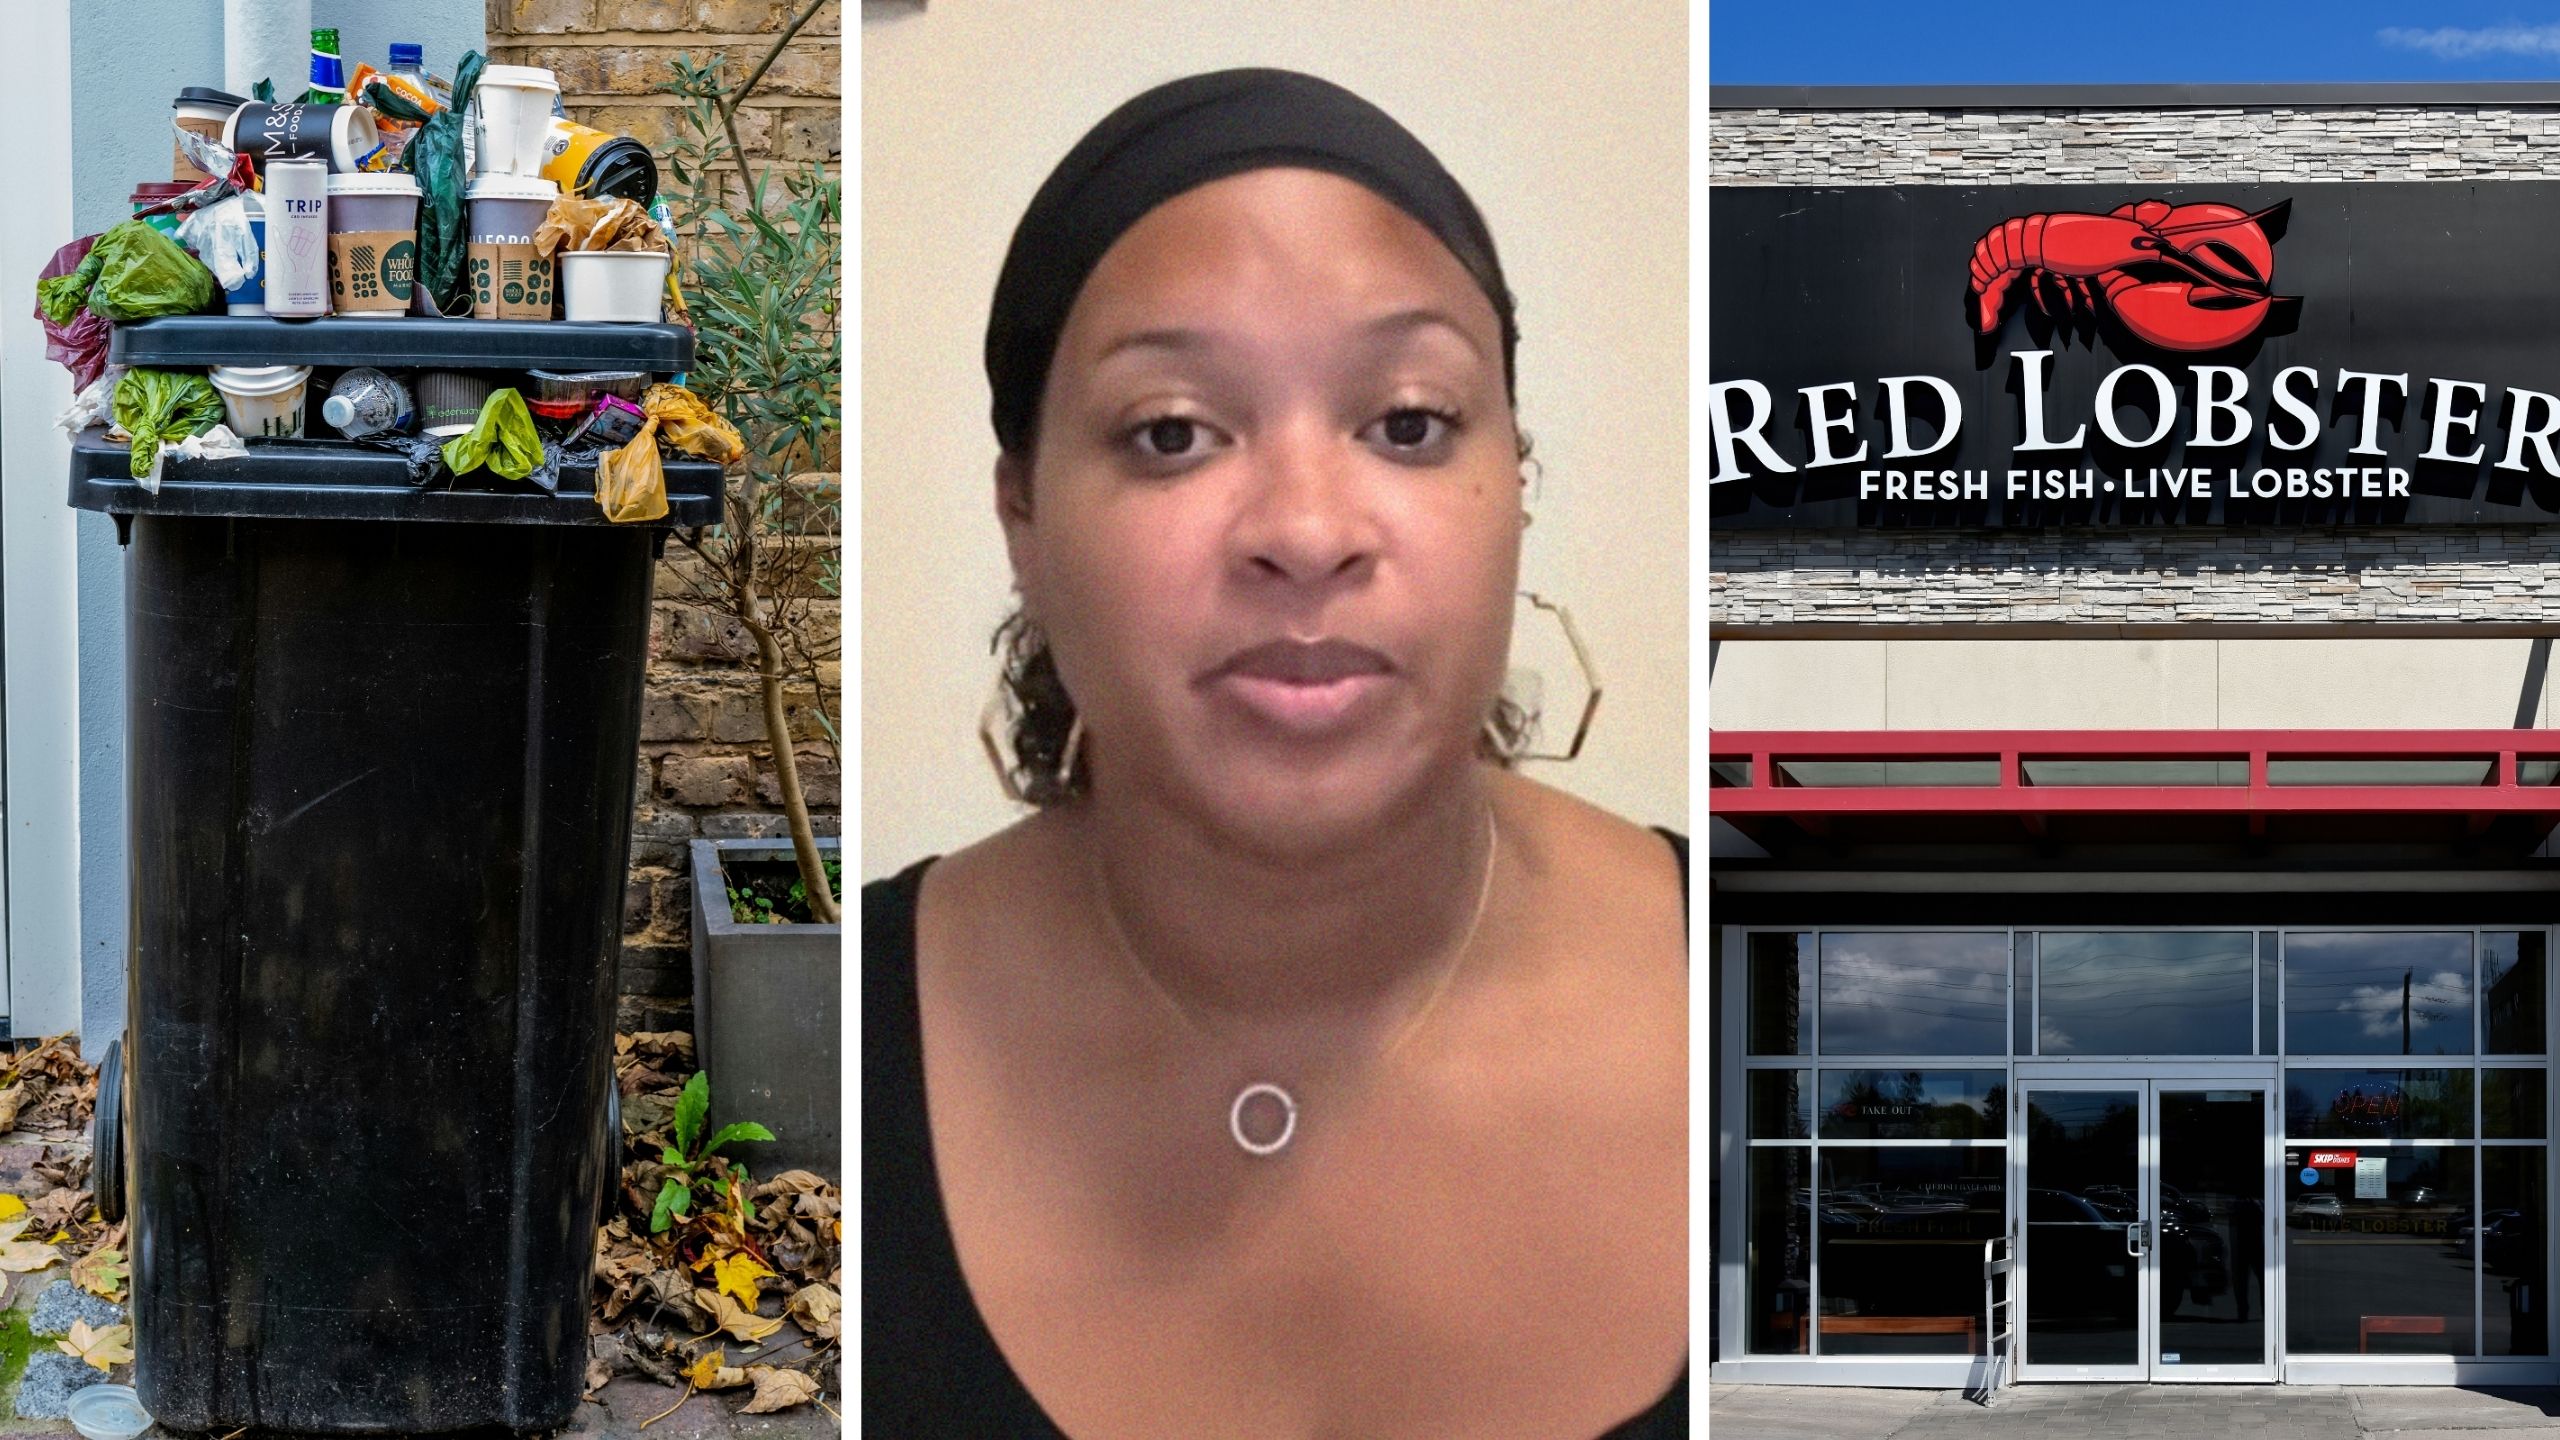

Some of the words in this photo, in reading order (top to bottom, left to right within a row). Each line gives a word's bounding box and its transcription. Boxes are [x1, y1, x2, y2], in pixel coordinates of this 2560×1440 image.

[395, 85, 423, 108] COCOA
[285, 199, 322, 213] TRIP
[1709, 374, 1963, 482] RED
[2009, 350, 2560, 479] LOBSTER
[1859, 469, 1988, 501] FRESH
[2006, 468, 2094, 499] FISH
[2124, 468, 2213, 499] LIVE
[2230, 467, 2412, 499] LOBSTER
[1861, 1106, 1887, 1115] TAKE
[1891, 1106, 1913, 1115] OUT
[2334, 1095, 2400, 1115] OPEN
[2313, 1153, 2334, 1164] SKIP
[2361, 1219, 2448, 1233] LOBSTER
